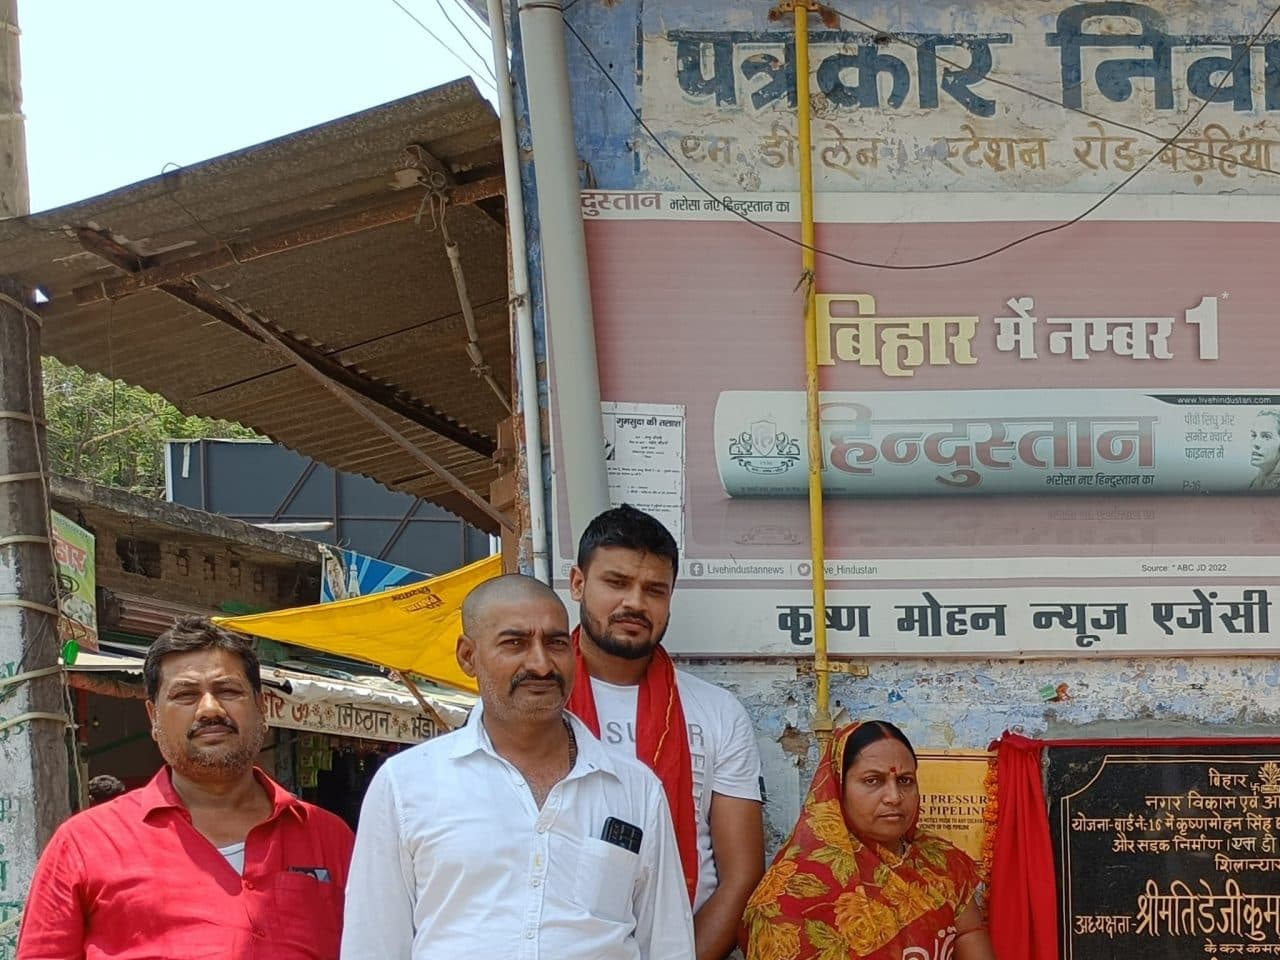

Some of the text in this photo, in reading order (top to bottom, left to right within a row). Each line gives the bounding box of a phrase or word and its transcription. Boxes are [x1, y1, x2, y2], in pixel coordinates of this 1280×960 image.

[667, 30, 1013, 117] पत्रकार
[669, 196, 700, 212] भरोसा
[776, 200, 790, 212] का
[815, 294, 1219, 376] बिहार में नम्बर 1
[1177, 396, 1271, 405] www.livehindustan.com
[646, 417, 657, 427] की
[808, 402, 1159, 488] हिन्दुस्तान
[1047, 473, 1156, 488] भरोसा नए हिन्दुस्तान का
[707, 564, 784, 575] Livehindustannews
[824, 564, 878, 575] ve_Hindustan
[1208, 564, 1227, 572] 2022
[776, 589, 1272, 648] कृष्ण मोहन न्यूज एजेंसी
[1208, 767, 1248, 789] बिहार
[931, 794, 988, 804] PRESSUR
[1145, 795, 1184, 811] नगर
[1188, 790, 1236, 809] विकास
[1239, 791, 1259, 812] एवं
[1165, 812, 1175, 831] में
[1246, 812, 1272, 833] सिंह
[1112, 832, 1136, 853] और
[1137, 840, 1170, 854] सड़क
[1173, 834, 1223, 852] निर्माण
[1261, 834, 1277, 854] डी
[1136, 879, 1199, 937] श्रीमति
[1198, 878, 1244, 938] डेजी
[1204, 938, 1217, 954] के
[1220, 943, 1244, 955] कर
